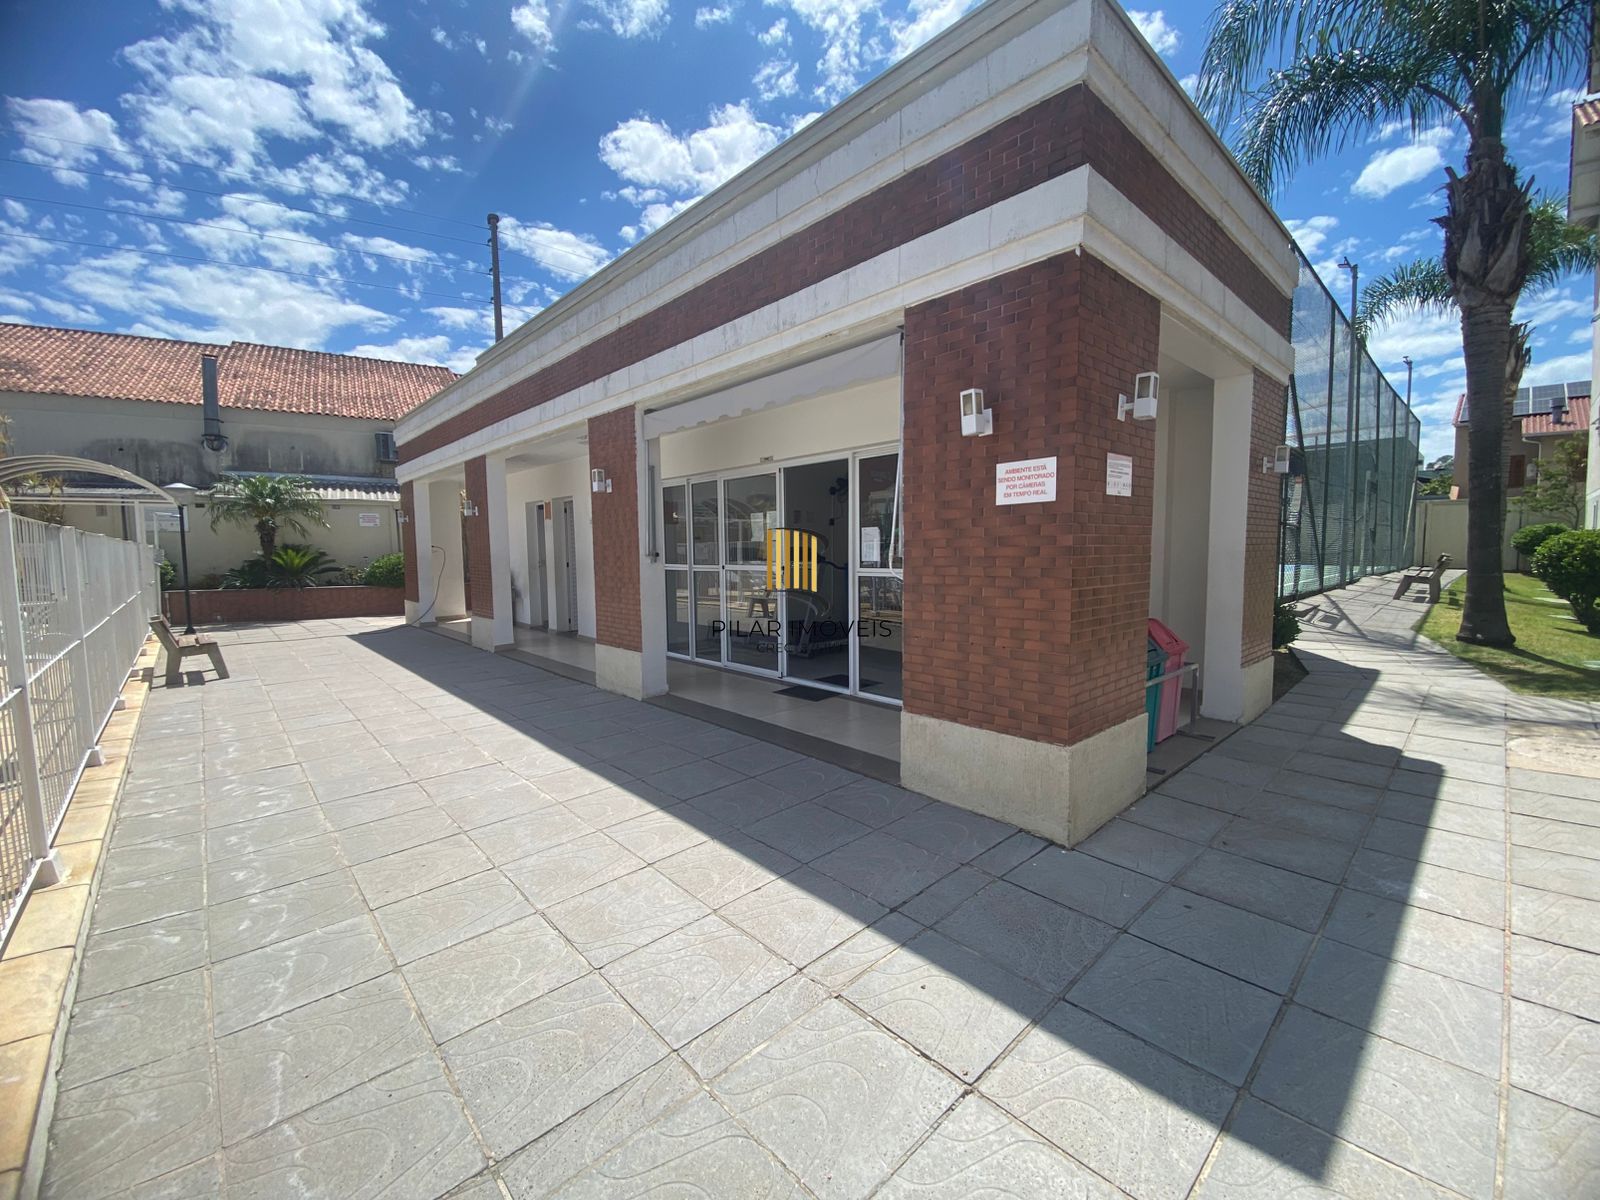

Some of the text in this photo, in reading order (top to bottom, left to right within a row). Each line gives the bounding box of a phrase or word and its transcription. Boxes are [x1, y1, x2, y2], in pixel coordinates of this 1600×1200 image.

[1005, 466, 1032, 475] AMBIENTE
[1017, 472, 1055, 482] MONITORADO
[1018, 481, 1045, 489] CÂMERAS
